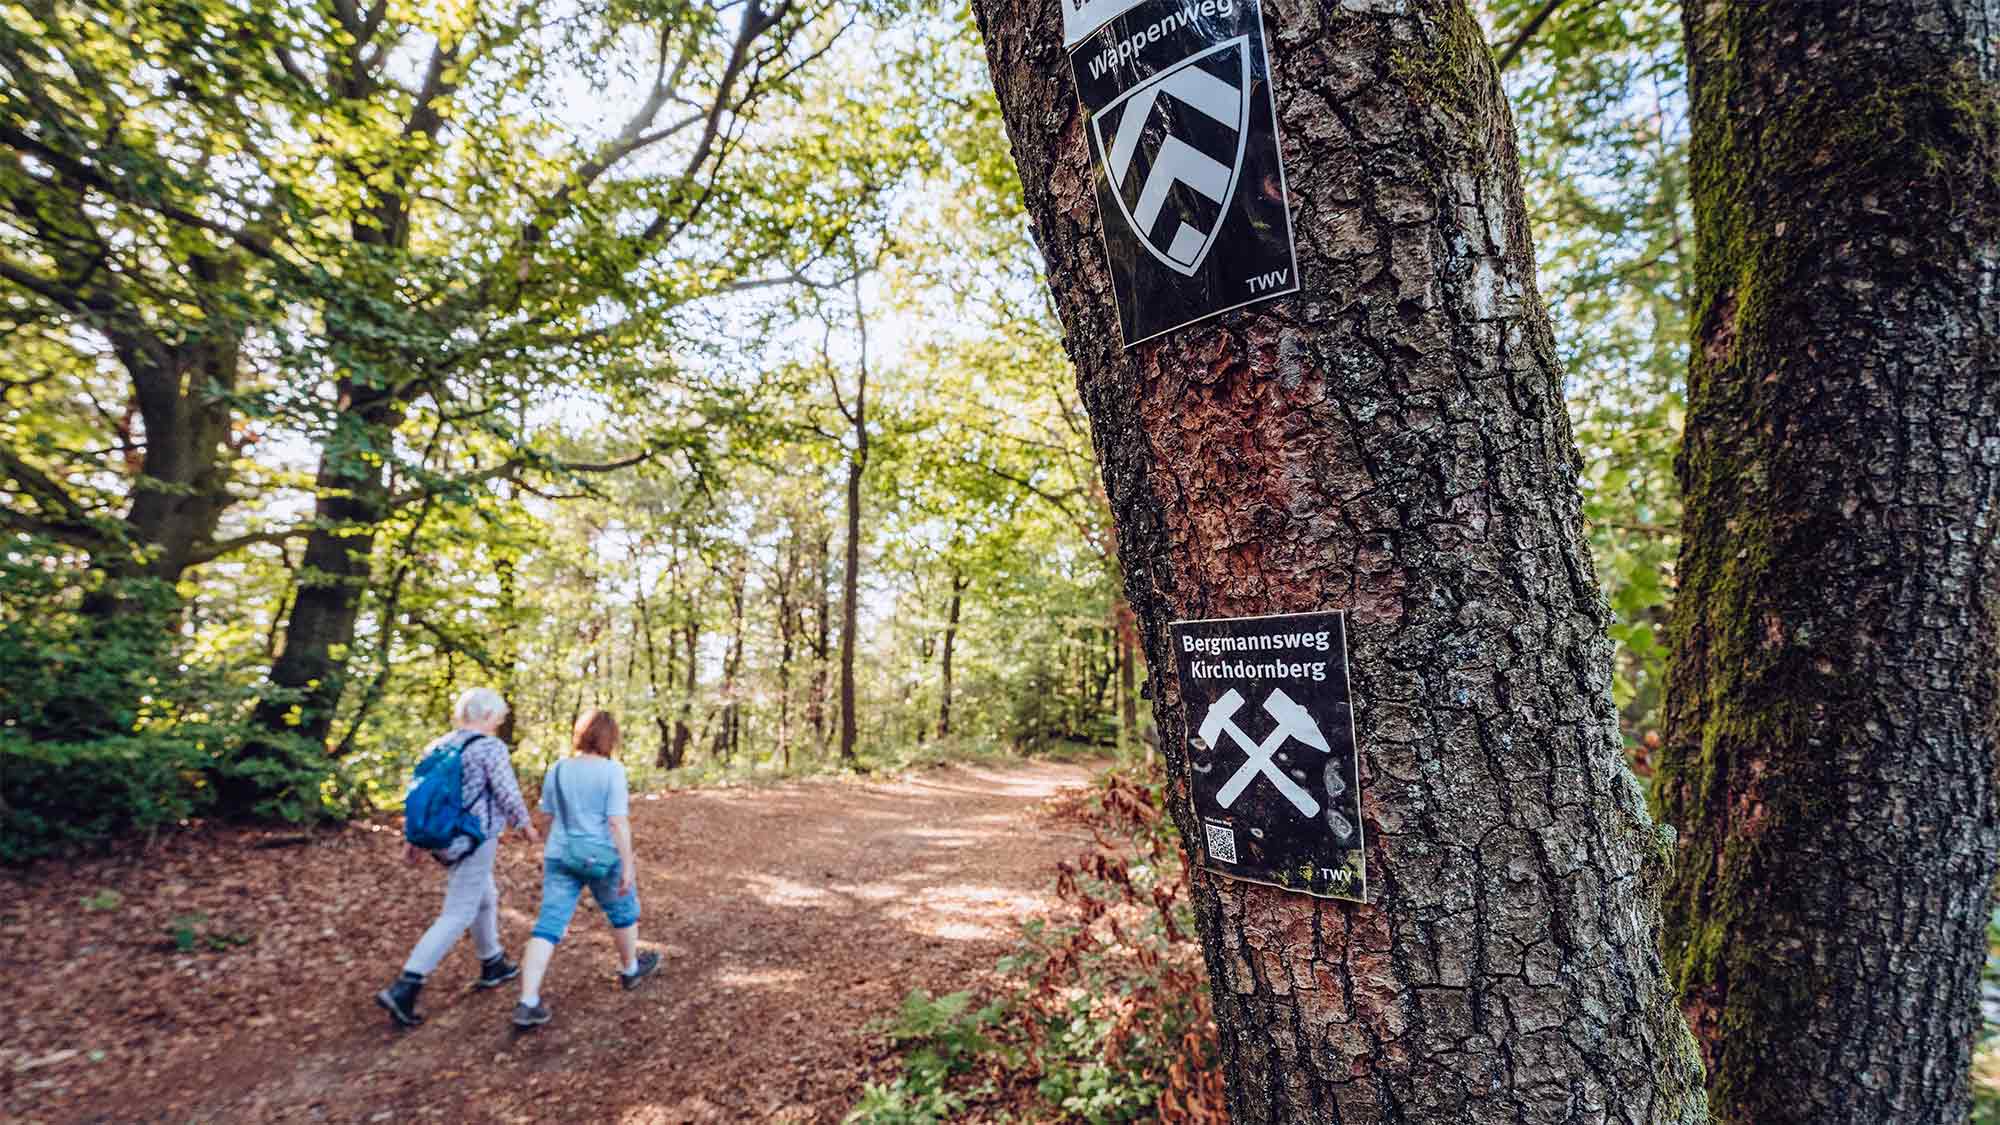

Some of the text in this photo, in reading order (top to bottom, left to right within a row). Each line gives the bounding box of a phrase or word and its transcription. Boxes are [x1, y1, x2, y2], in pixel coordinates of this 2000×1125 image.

[1087, 0, 1233, 80] Wappenweg
[1245, 268, 1288, 293] TWV
[1182, 631, 1331, 655] Bergmannsweg
[1191, 659, 1327, 681] Kirchdornberg
[1321, 867, 1352, 881] TWV
